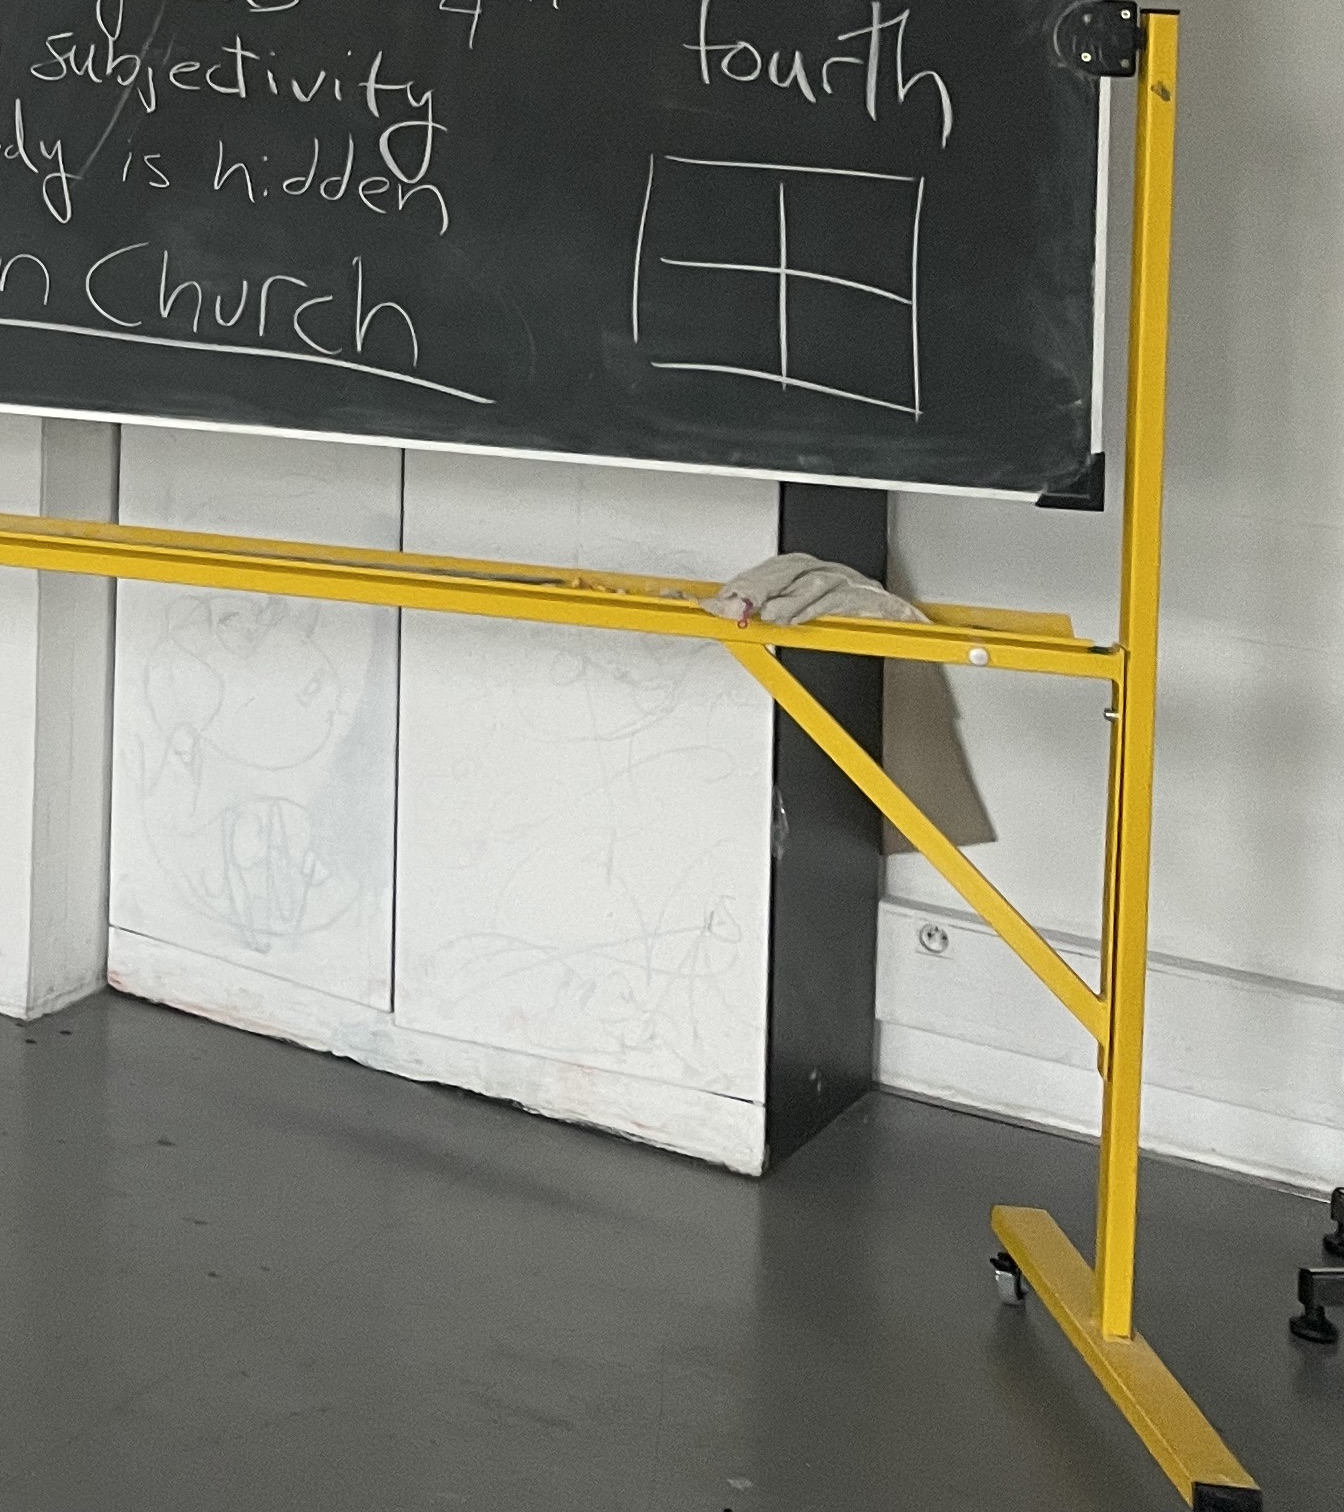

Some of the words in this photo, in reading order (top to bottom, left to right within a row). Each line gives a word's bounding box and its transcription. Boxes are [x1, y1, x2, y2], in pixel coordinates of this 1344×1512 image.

[30, 32, 448, 184] subjectivity
[122, 138, 171, 189] is
[213, 134, 450, 236] hidden
[85, 242, 419, 367] Church
